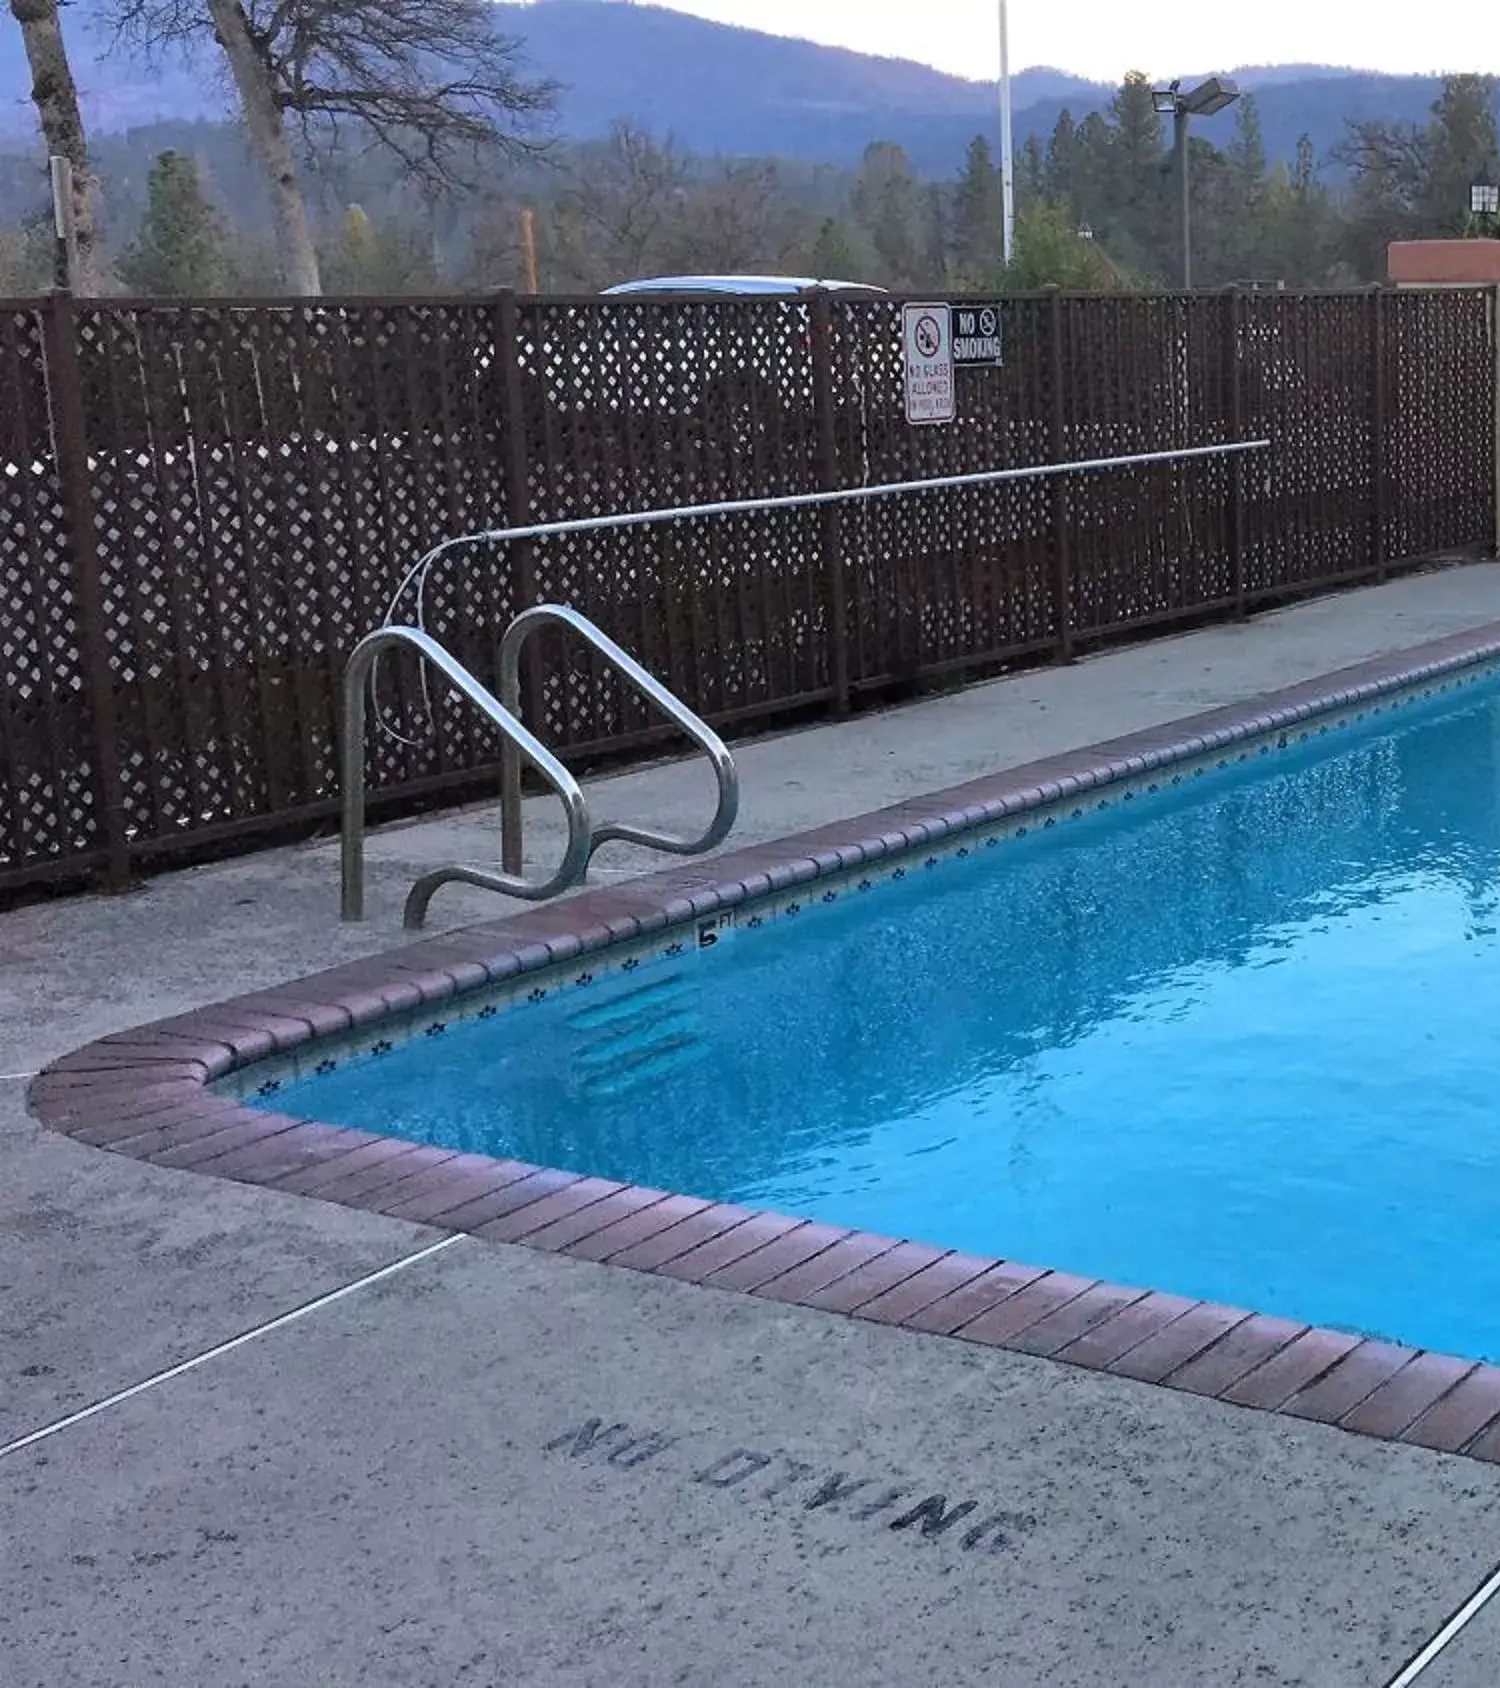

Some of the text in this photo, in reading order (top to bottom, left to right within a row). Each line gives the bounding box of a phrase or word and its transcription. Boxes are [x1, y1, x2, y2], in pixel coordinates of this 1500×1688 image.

[959, 313, 974, 335] NO
[954, 336, 1001, 359] SMOKING
[923, 363, 949, 377] GLASS
[911, 381, 949, 396] ALLOWED
[699, 919, 719, 948] 5
